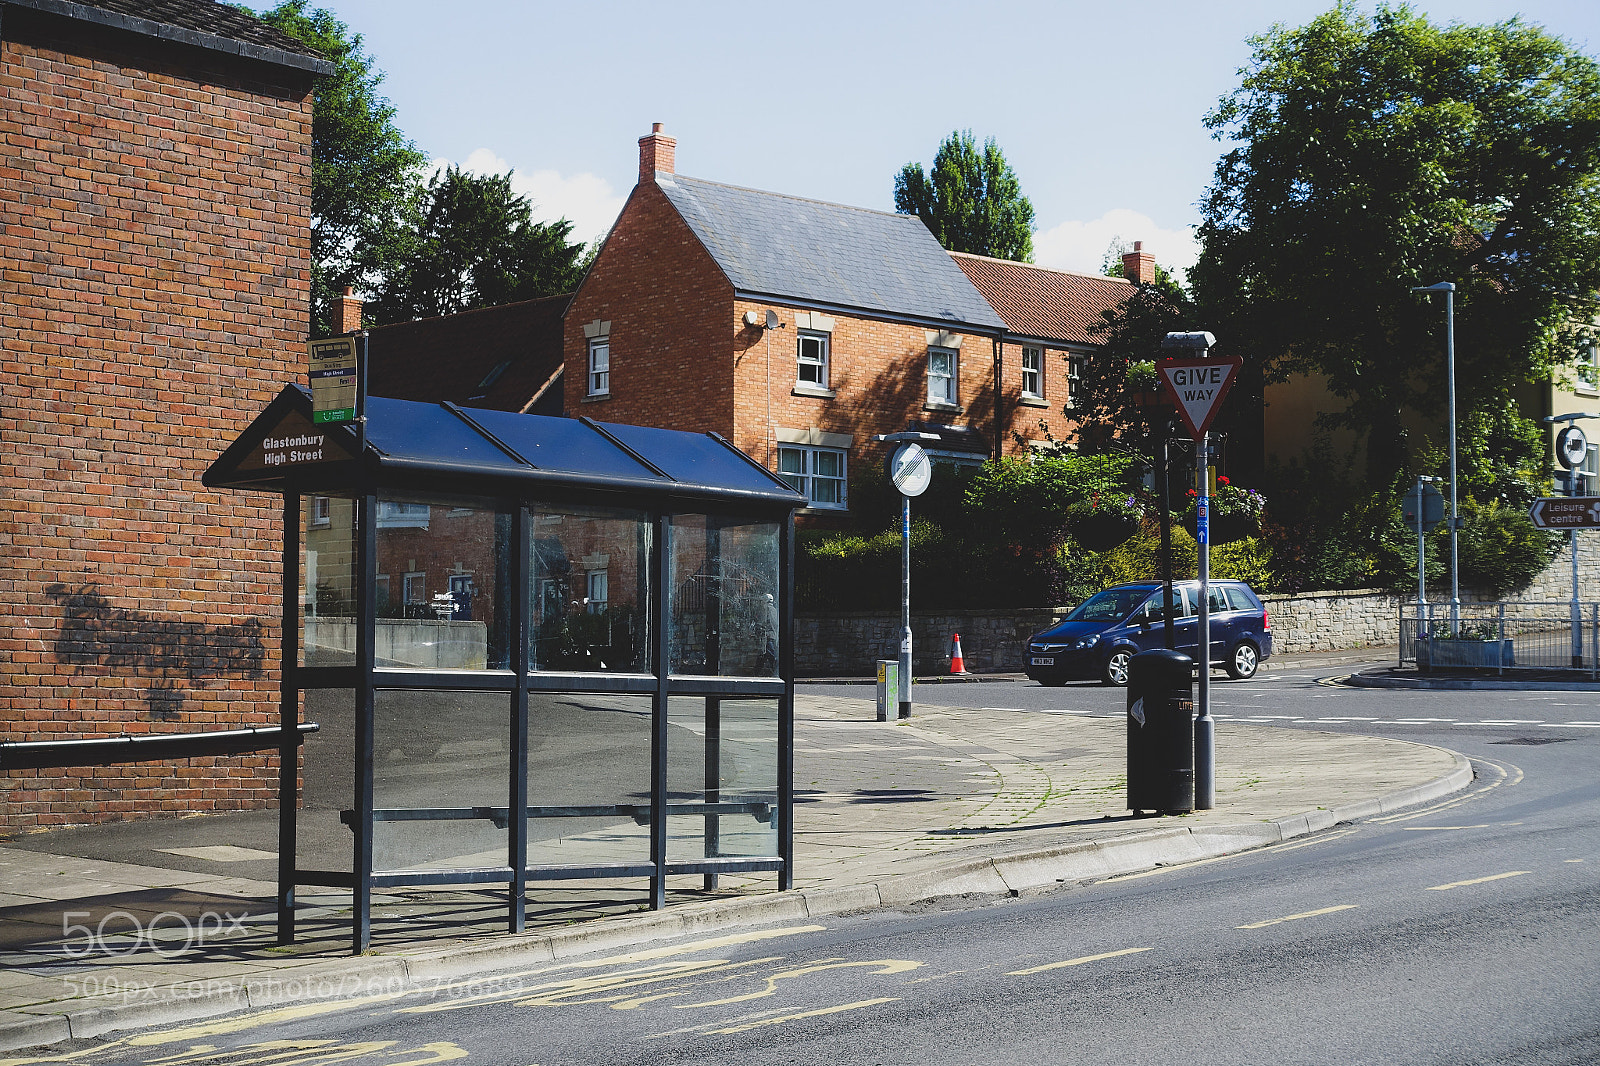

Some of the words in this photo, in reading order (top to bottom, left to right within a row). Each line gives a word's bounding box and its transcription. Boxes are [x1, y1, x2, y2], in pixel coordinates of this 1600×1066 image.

[1173, 367, 1221, 386] GIVE
[1184, 389, 1214, 402] WAY
[263, 434, 325, 450] Glastonbury
[264, 452, 286, 466] High
[290, 448, 323, 462] Street
[1549, 502, 1586, 512] Leisure
[1550, 514, 1584, 524] centre
